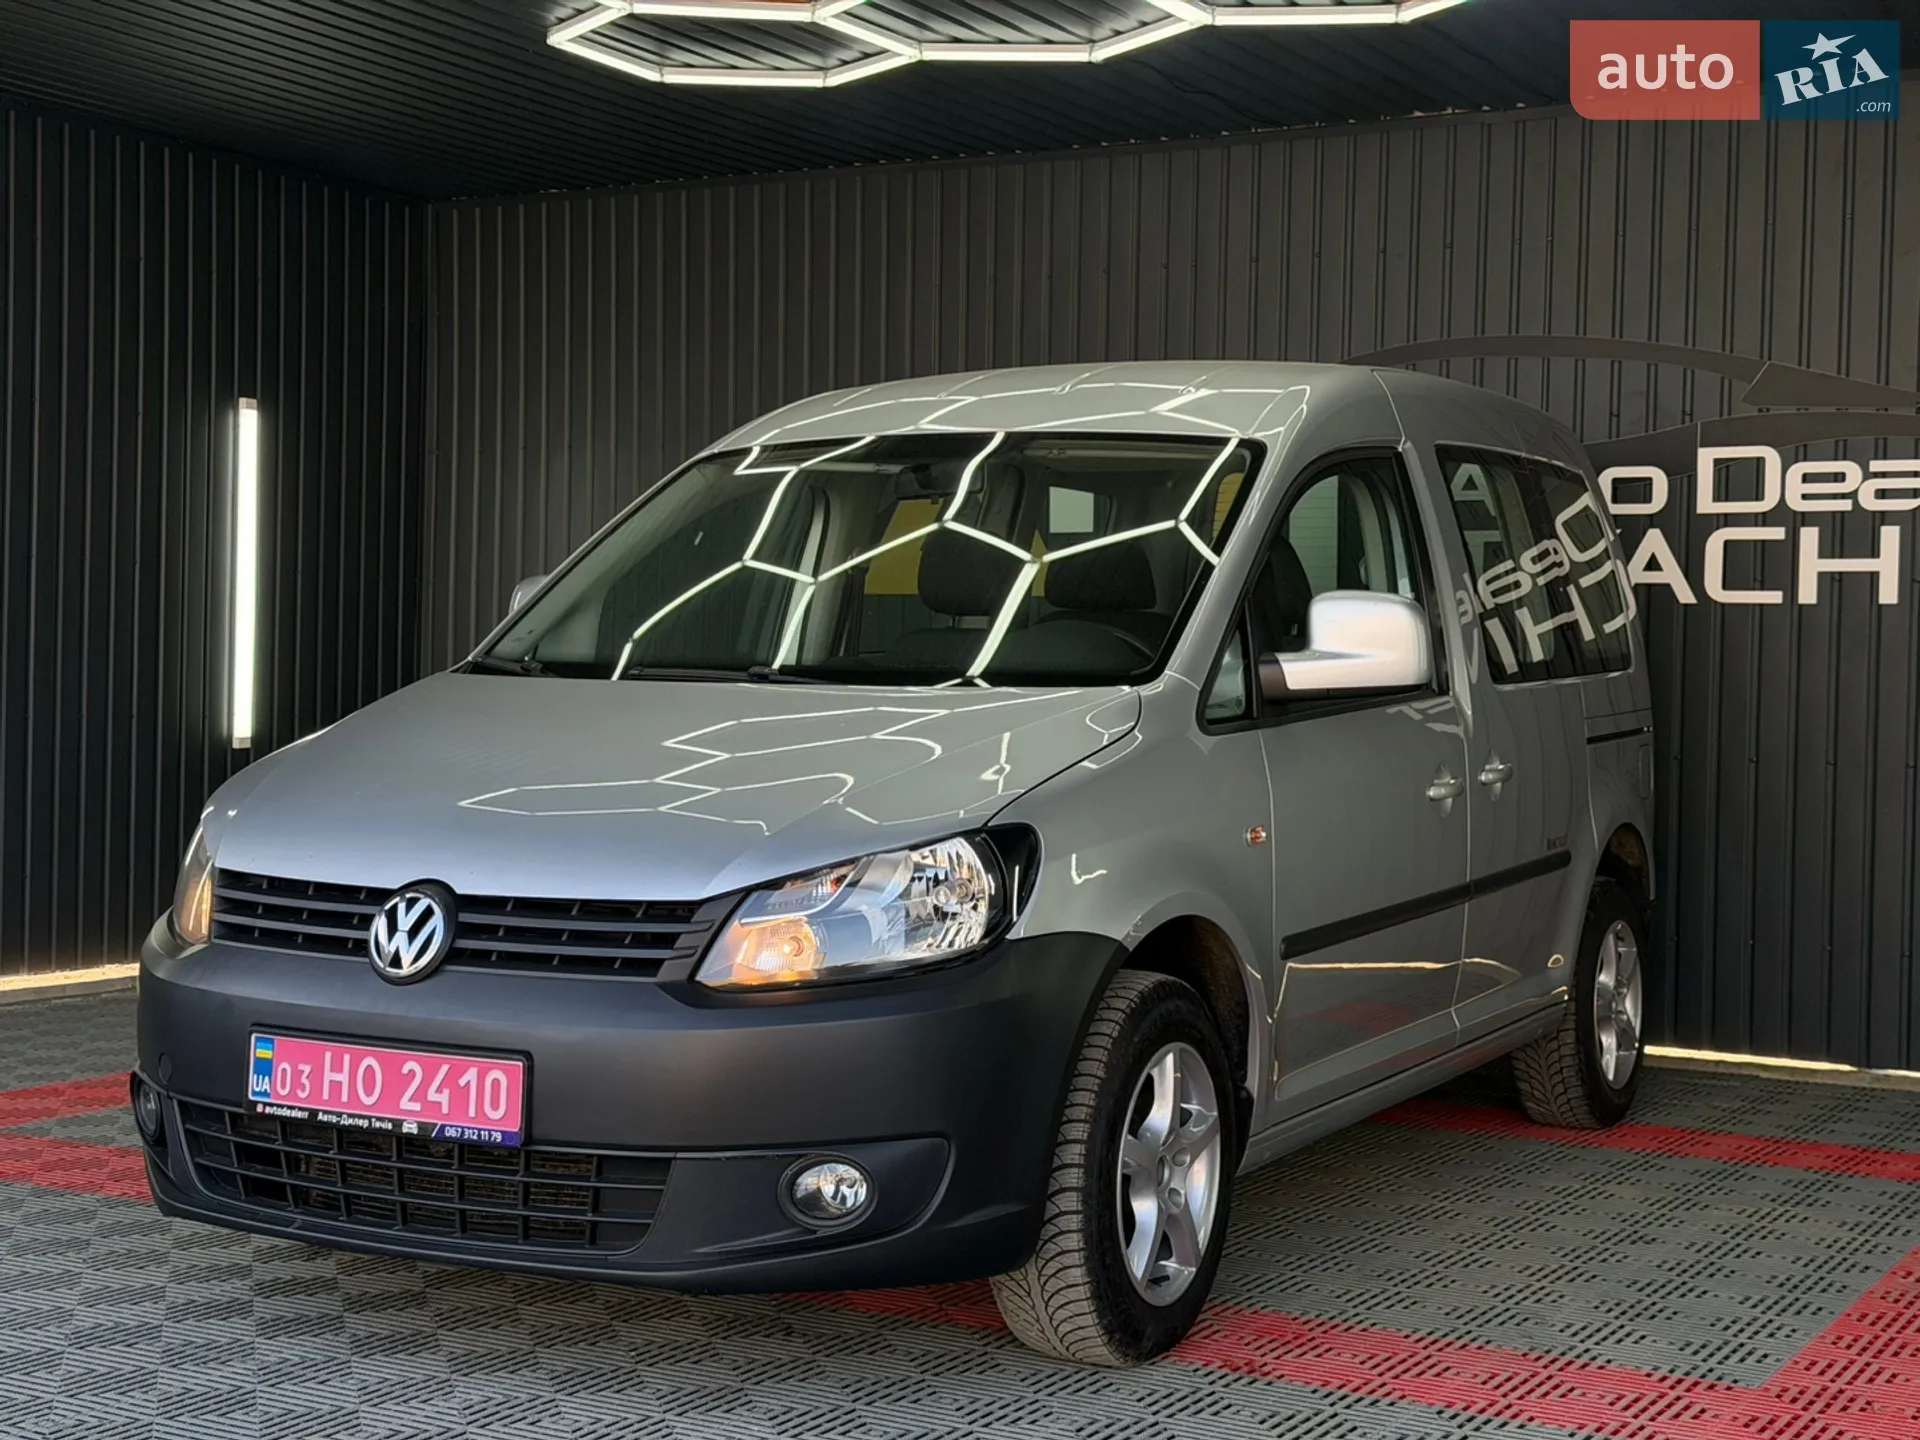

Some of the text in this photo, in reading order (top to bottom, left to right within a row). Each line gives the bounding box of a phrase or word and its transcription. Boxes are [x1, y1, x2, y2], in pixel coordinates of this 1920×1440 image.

[252, 1074, 271, 1093] UA
[276, 1051, 509, 1120] 03 HO 2410
[445, 1126, 502, 1142] 067 312 11 79
